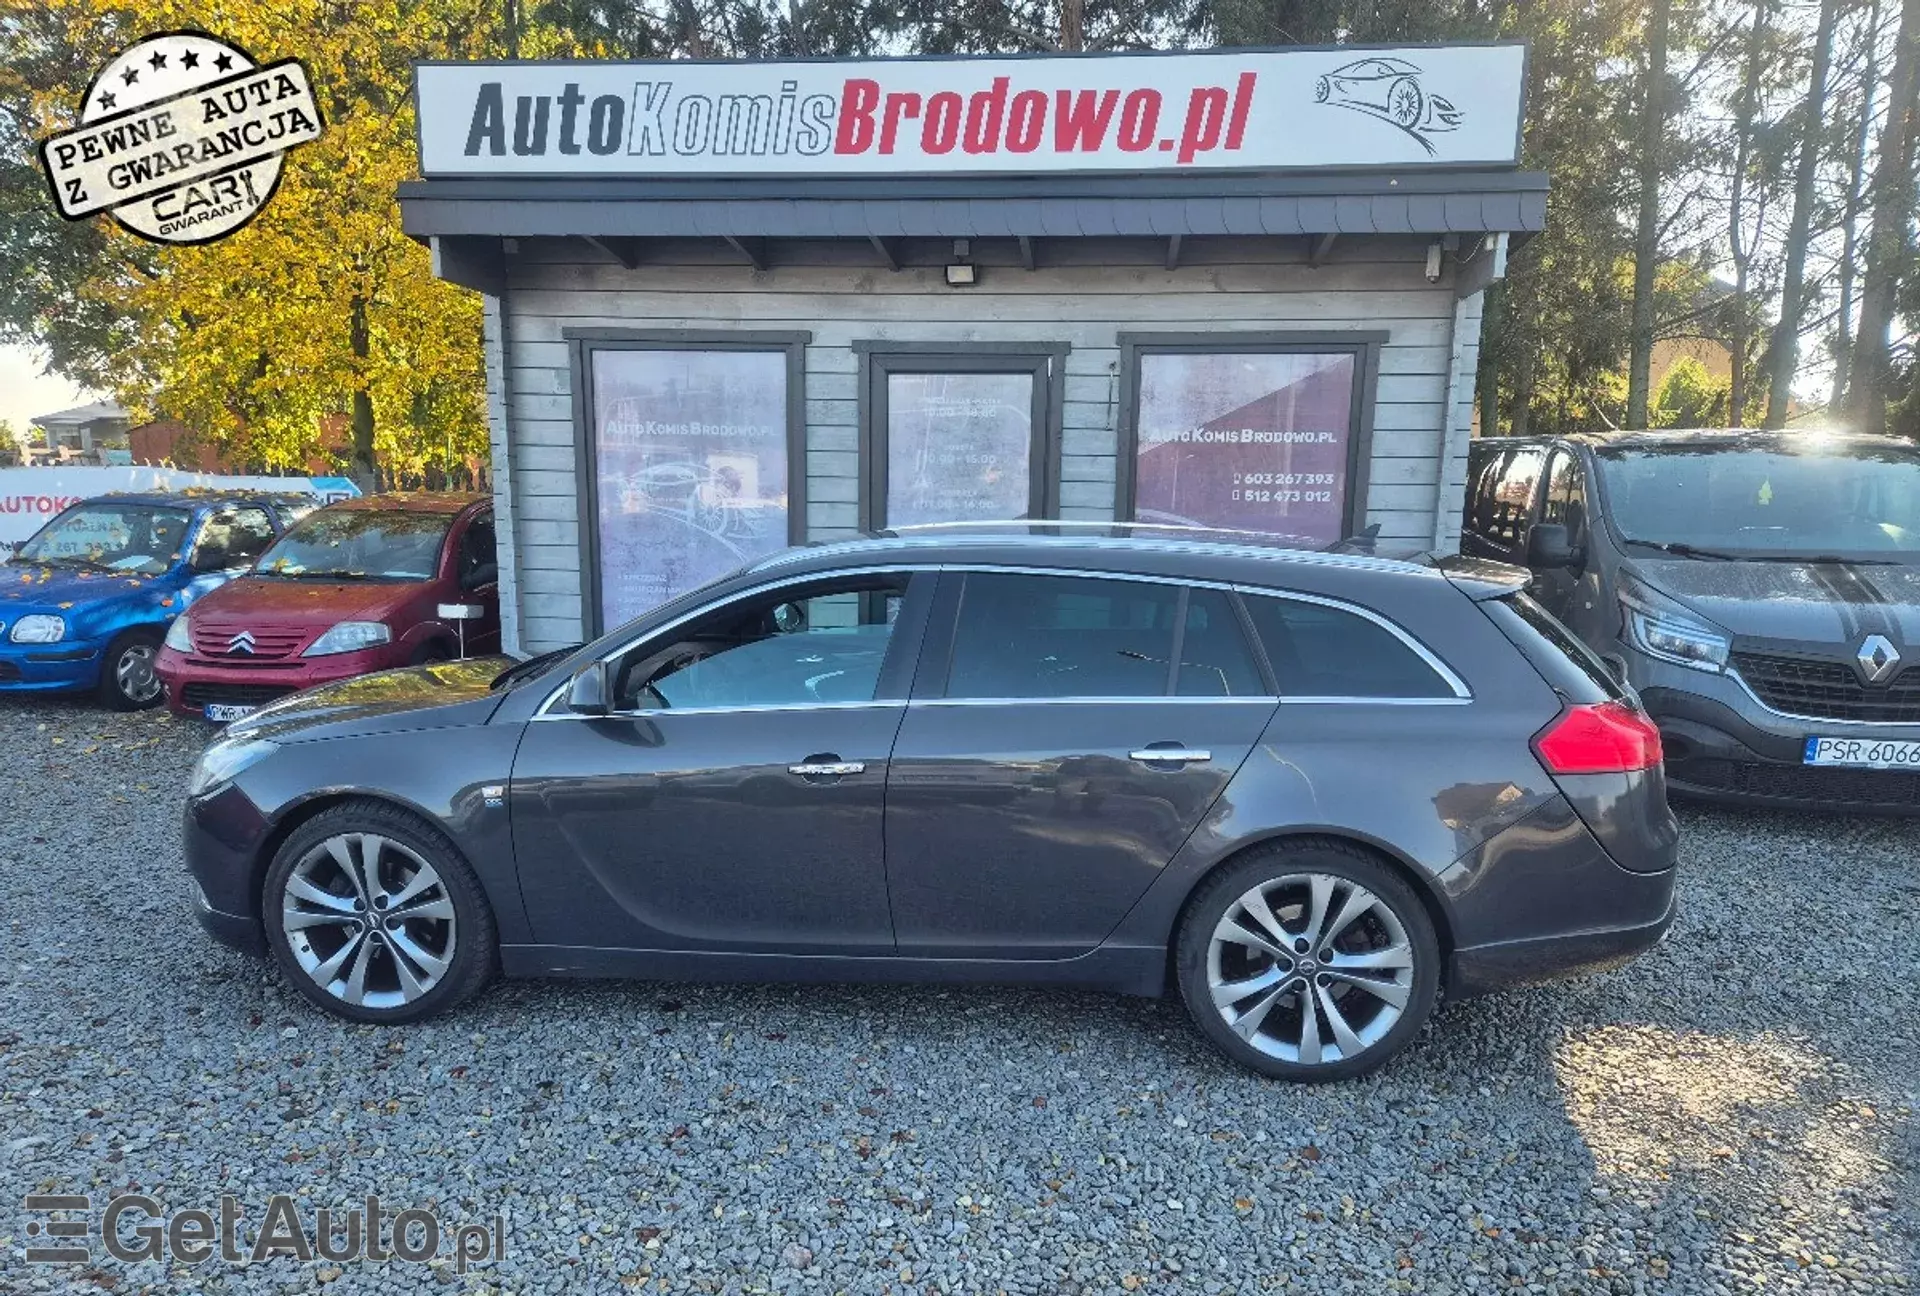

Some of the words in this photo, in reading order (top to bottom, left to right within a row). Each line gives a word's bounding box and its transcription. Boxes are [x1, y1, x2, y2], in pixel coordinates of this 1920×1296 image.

[464, 72, 1257, 163] AutoKomisBrodowo.pl
[1244, 473, 1273, 485] 603
[1275, 473, 1303, 485] 267
[1305, 473, 1334, 485] 393
[1244, 490, 1270, 502] 512
[1274, 490, 1301, 502] 473
[1305, 490, 1331, 502] 012
[1817, 740, 1861, 760] PSR
